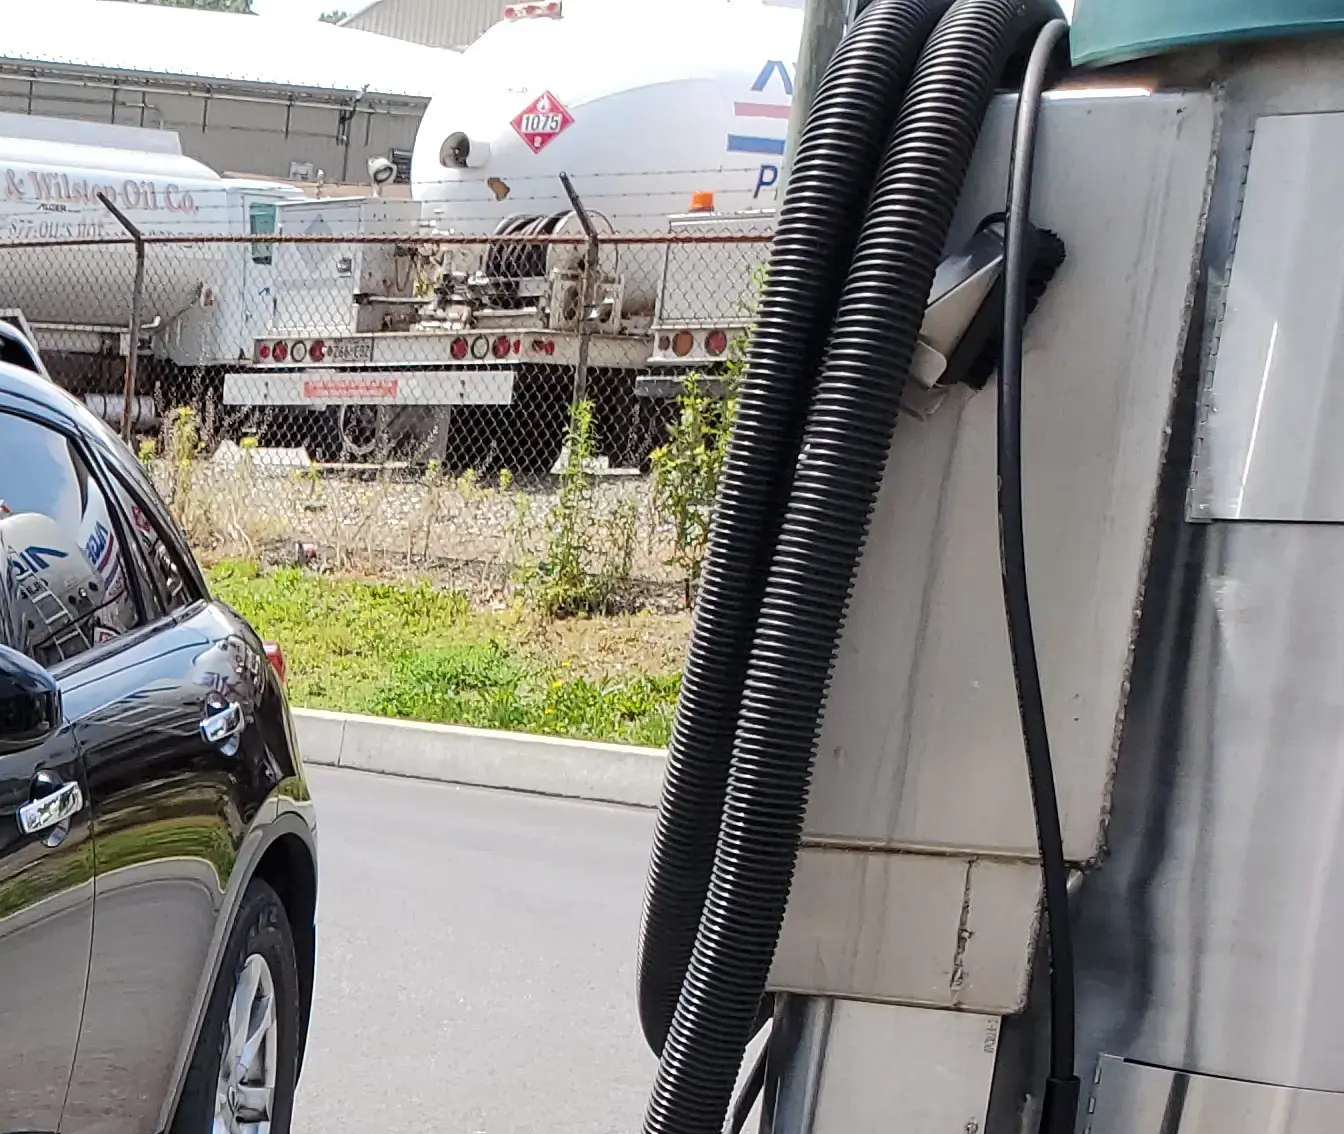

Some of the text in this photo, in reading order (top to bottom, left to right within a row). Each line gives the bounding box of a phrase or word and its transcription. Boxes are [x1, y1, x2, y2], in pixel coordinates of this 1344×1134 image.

[524, 113, 559, 132] 1075
[5, 168, 25, 199] &
[122, 179, 159, 211] Oil
